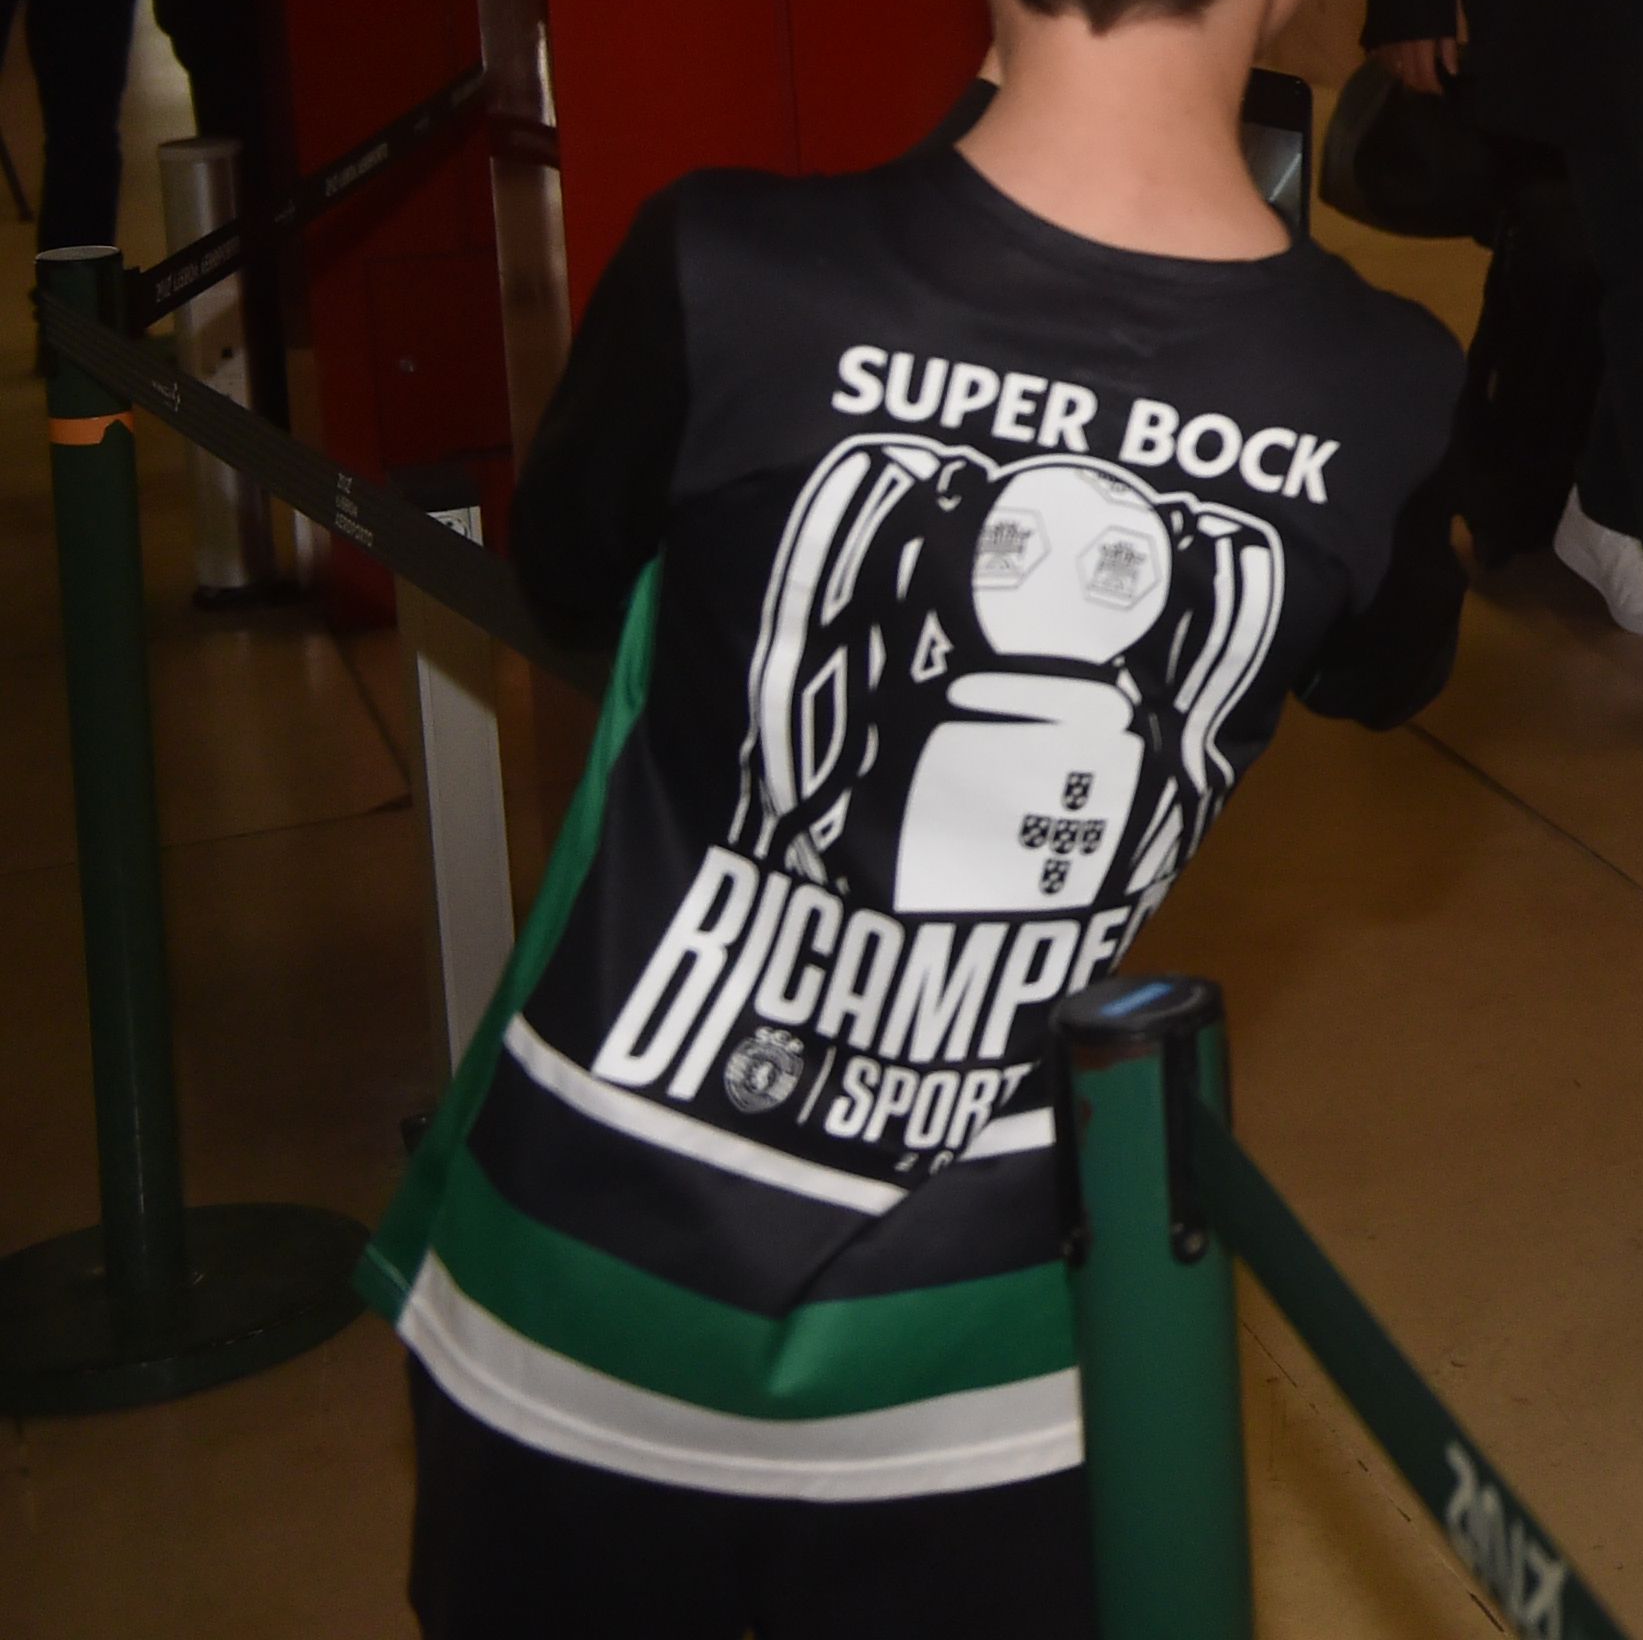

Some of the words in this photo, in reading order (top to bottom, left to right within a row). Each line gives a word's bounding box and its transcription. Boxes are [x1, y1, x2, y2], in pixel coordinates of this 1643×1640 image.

[831, 345, 1099, 453] SUPER
[1119, 398, 1341, 504] BOCK
[591, 843, 1158, 1102] BICAMPE
